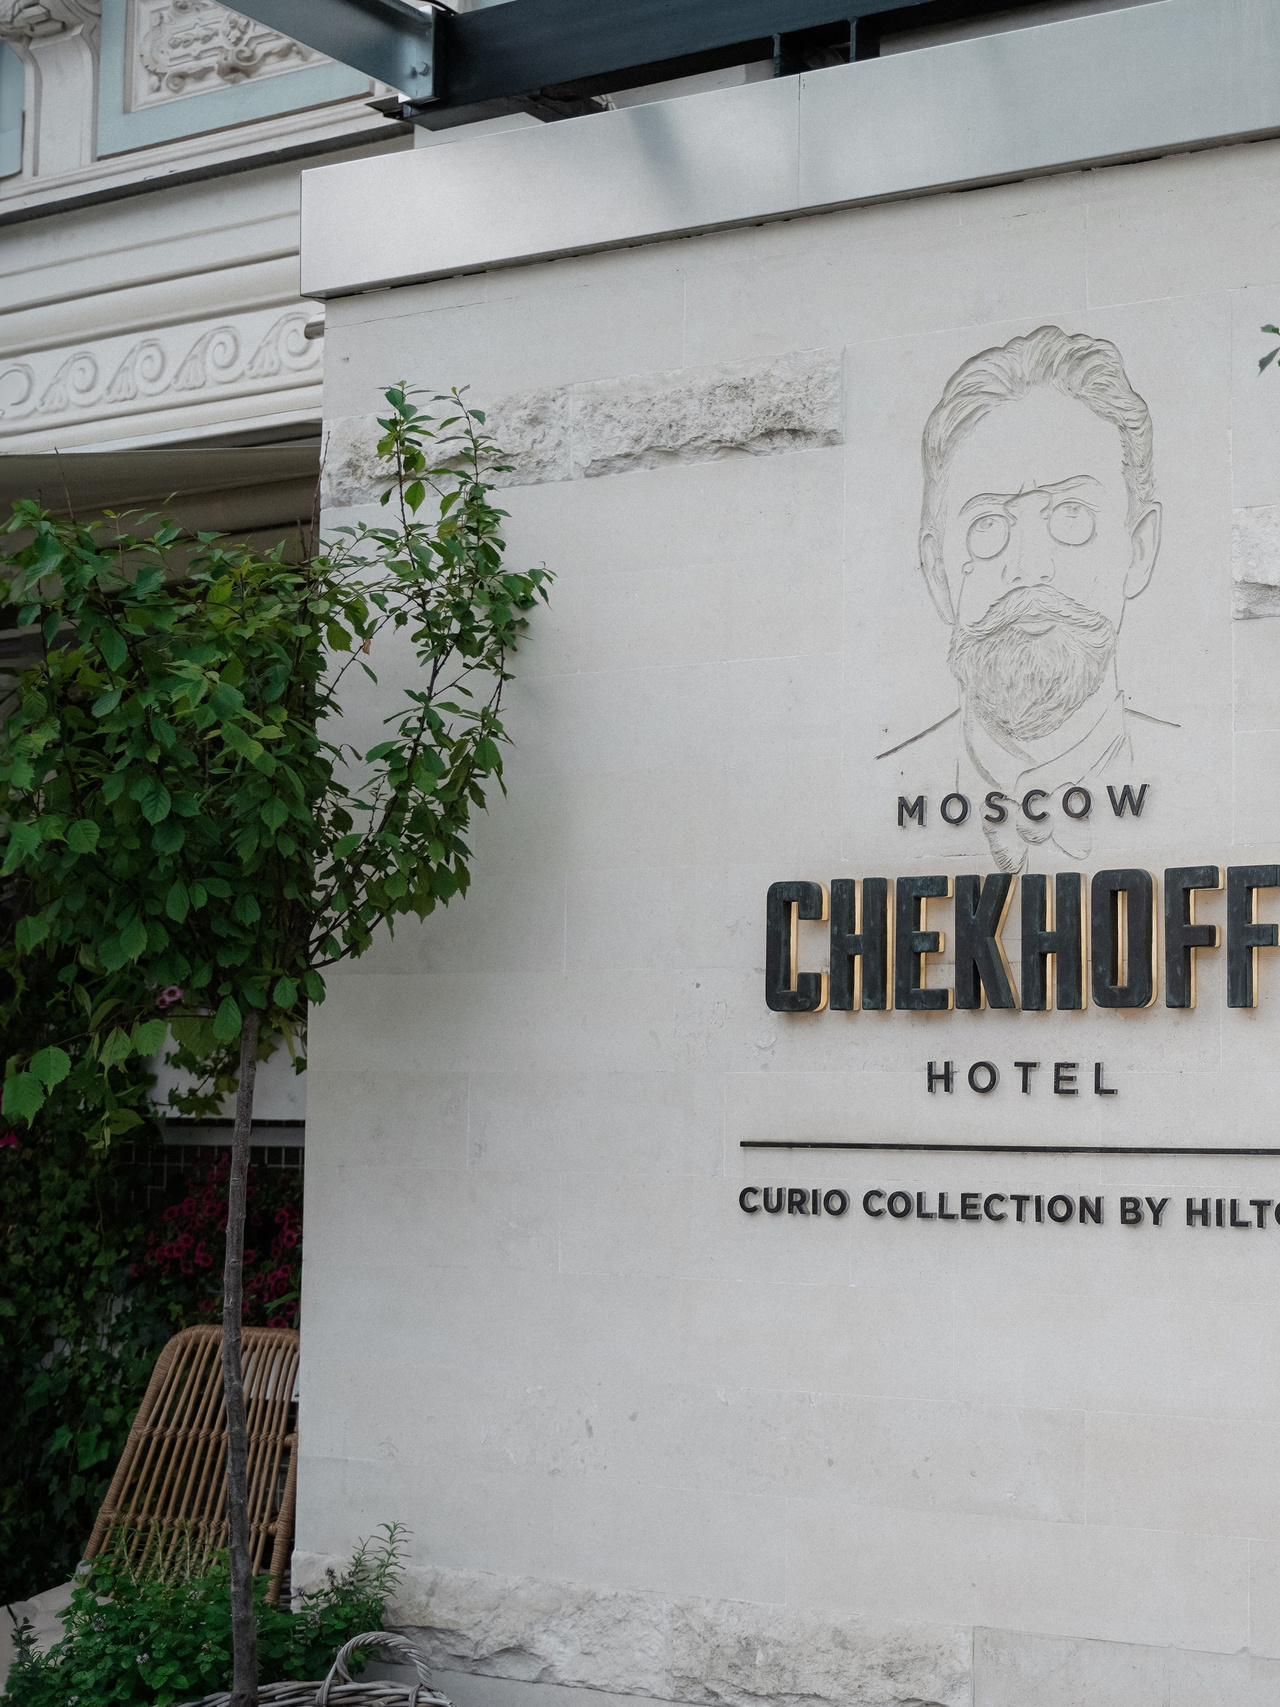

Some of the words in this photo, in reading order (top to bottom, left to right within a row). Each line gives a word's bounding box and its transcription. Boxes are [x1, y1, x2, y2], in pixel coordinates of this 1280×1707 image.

[897, 783, 1150, 827] MOSCOW
[926, 1060, 1118, 1095] HOTEL
[739, 1186, 851, 1216] CURIO
[862, 1188, 1104, 1225] COLLECTION
[1119, 1195, 1170, 1226] BY
